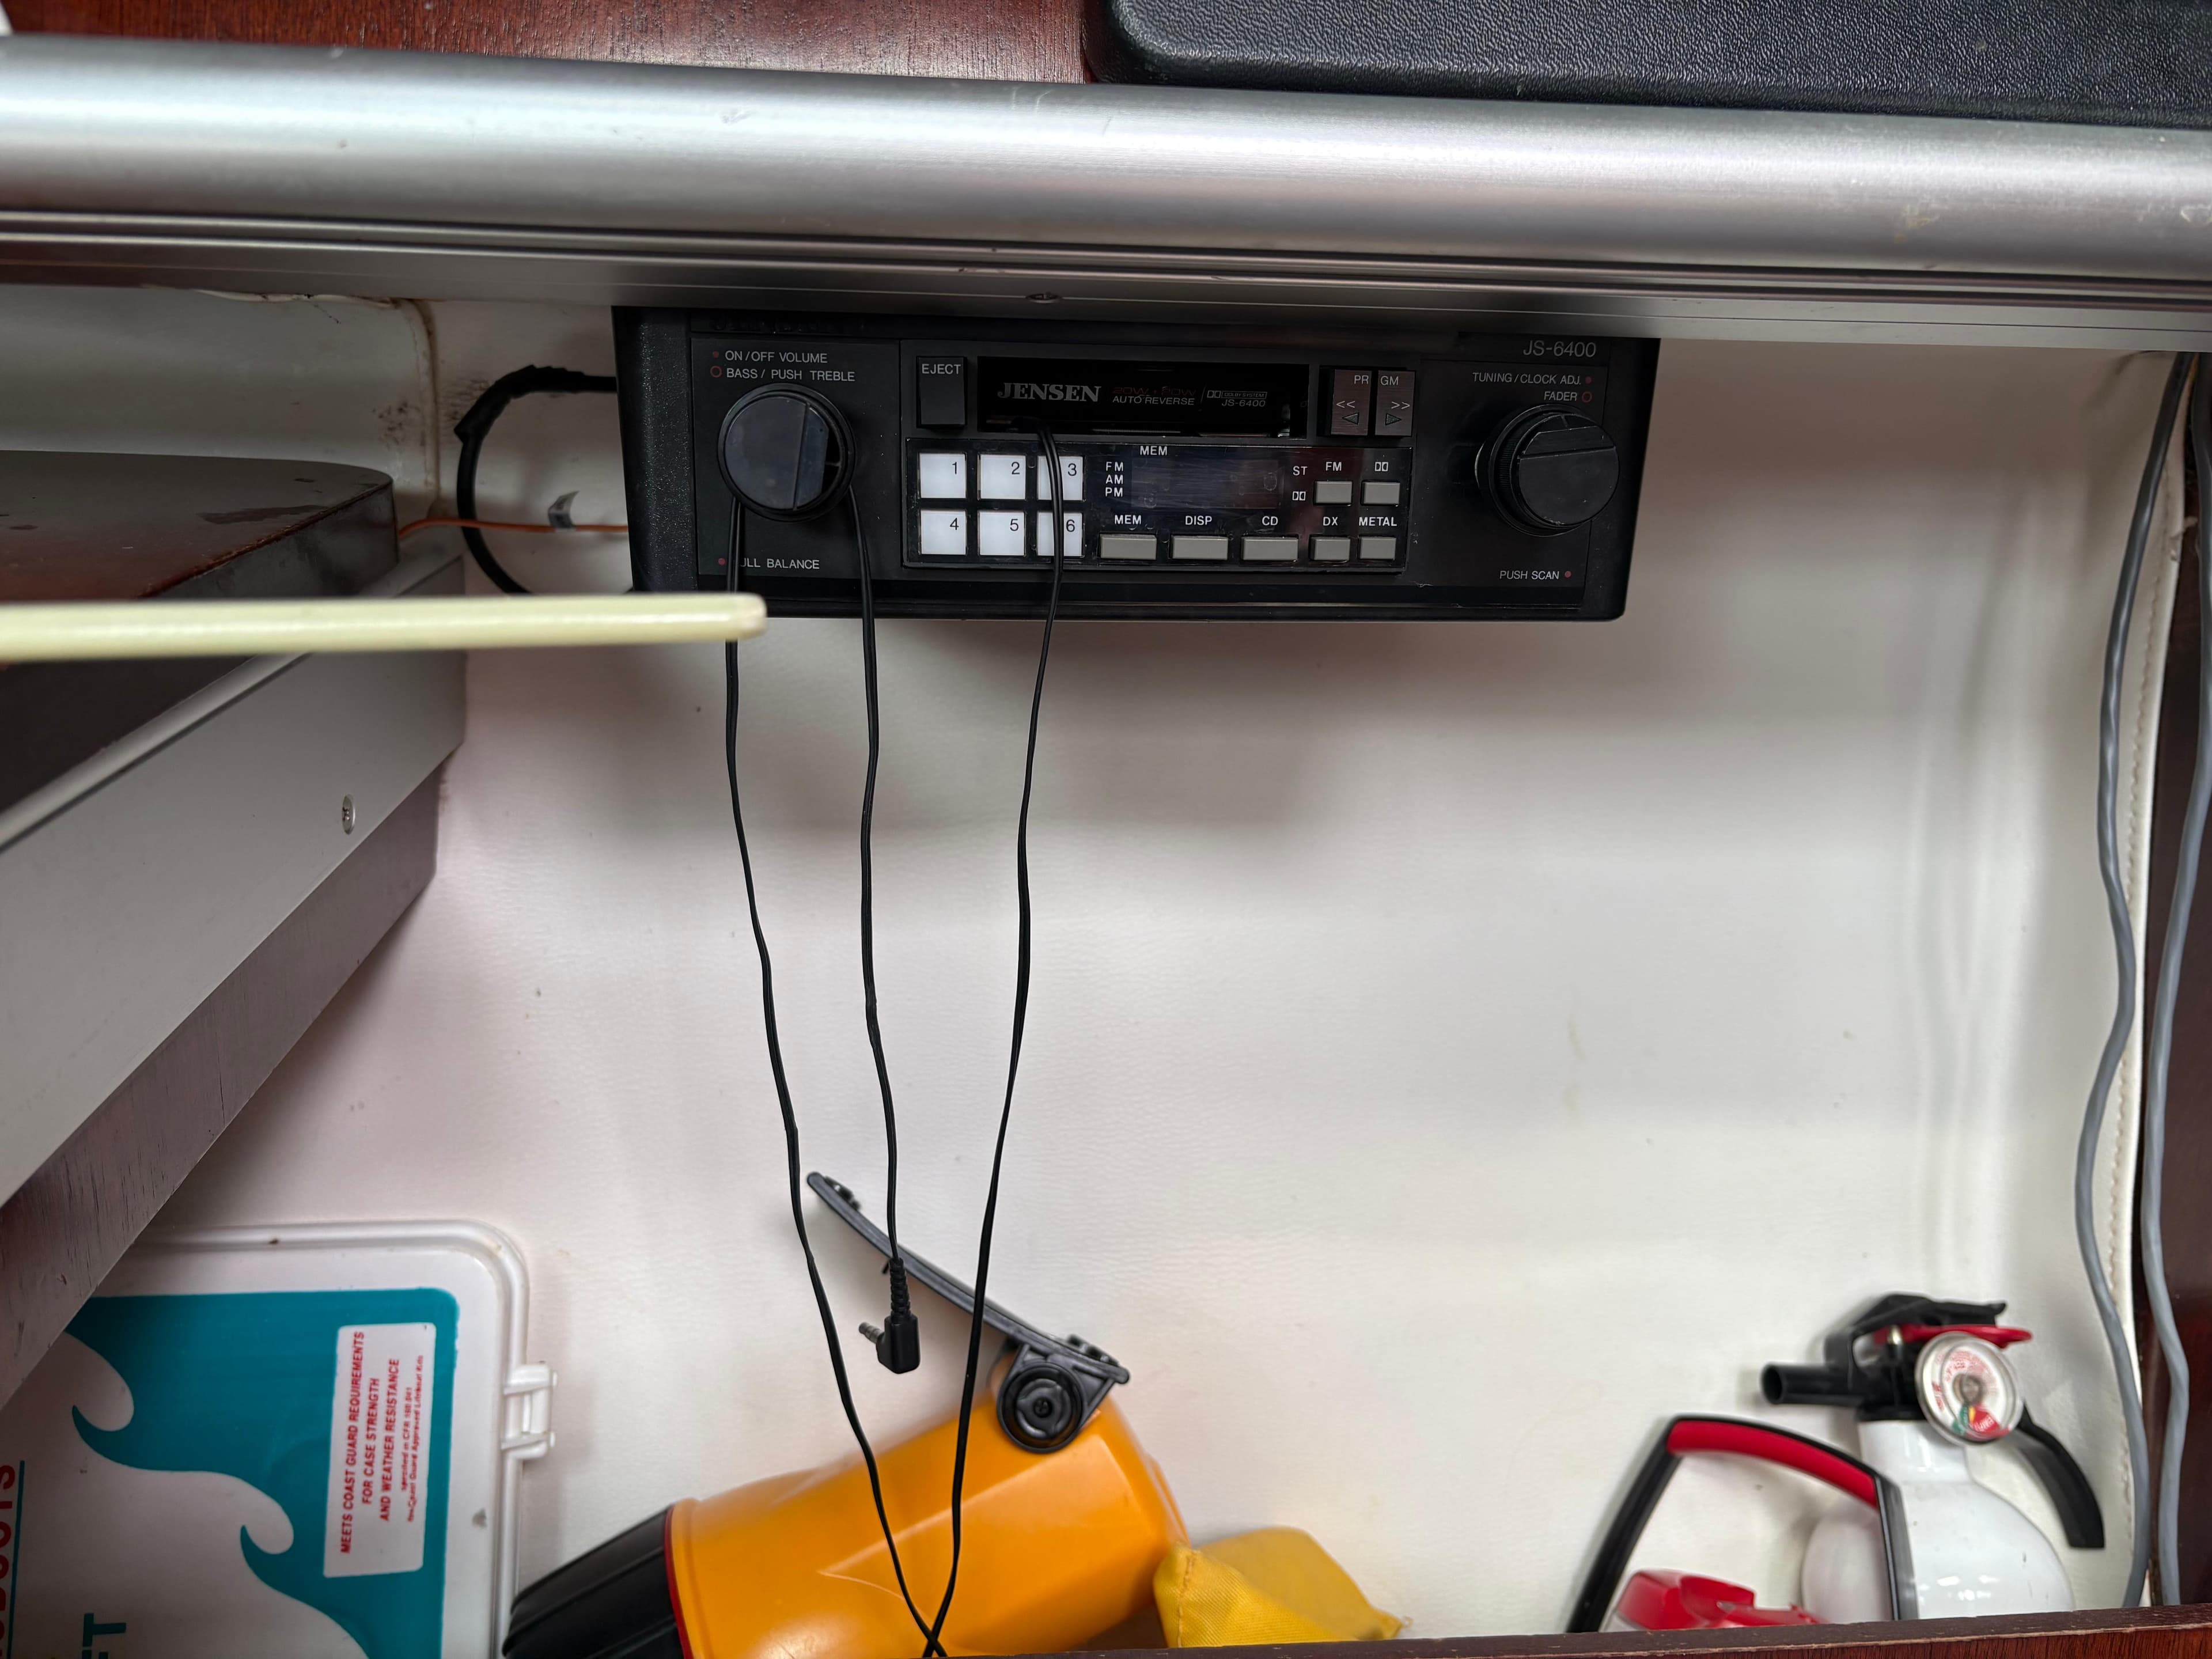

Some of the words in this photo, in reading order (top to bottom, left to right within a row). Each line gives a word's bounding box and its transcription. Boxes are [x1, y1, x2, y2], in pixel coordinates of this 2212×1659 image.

[1524, 340, 1596, 357] JS-6400
[779, 353, 827, 363] VOLUME
[922, 364, 961, 374] EJECT
[772, 369, 802, 380] PUSH
[810, 371, 855, 381] TREBLE
[1354, 375, 1369, 384] PR
[1560, 376, 1581, 384] ADJ.
[1381, 376, 1398, 385] GM
[998, 382, 1101, 402] JENSEN
[1544, 391, 1577, 401] FADER
[1112, 396, 1142, 404] AUTO
[1145, 396, 1195, 405] REVERSE
[1140, 445, 1168, 455] MEM
[952, 462, 957, 474] 1
[1012, 462, 1020, 475] 2
[1068, 463, 1077, 476] 3
[1106, 462, 1123, 471] FM
[1293, 466, 1307, 475] ST
[1326, 462, 1342, 471] FM
[1106, 475, 1123, 484] AM
[1105, 487, 1123, 497] PM
[950, 518, 959, 530] 4
[1115, 515, 1141, 524] MEM
[1185, 516, 1212, 525] DISP
[1262, 516, 1278, 525] CD
[1323, 517, 1338, 525] DX
[1359, 517, 1397, 526] METAL
[1010, 519, 1018, 531] 5
[1066, 520, 1075, 532] 6
[767, 559, 819, 569] BALANCE
[1500, 571, 1528, 579] PUSH
[1532, 571, 1559, 579] SCAN
[349, 1331, 364, 1421] REQUIREMENTS
[385, 1358, 399, 1431] RESISTANCE
[365, 1378, 380, 1441] STRENGTH
[346, 1426, 358, 1466] GUARD
[363, 1445, 376, 1476] CASE
[382, 1436, 394, 1491] WEATHER
[343, 1469, 355, 1509] COAST
[362, 1480, 373, 1504] FOR
[380, 1496, 391, 1521] AND
[340, 1514, 353, 1553] MEETS
